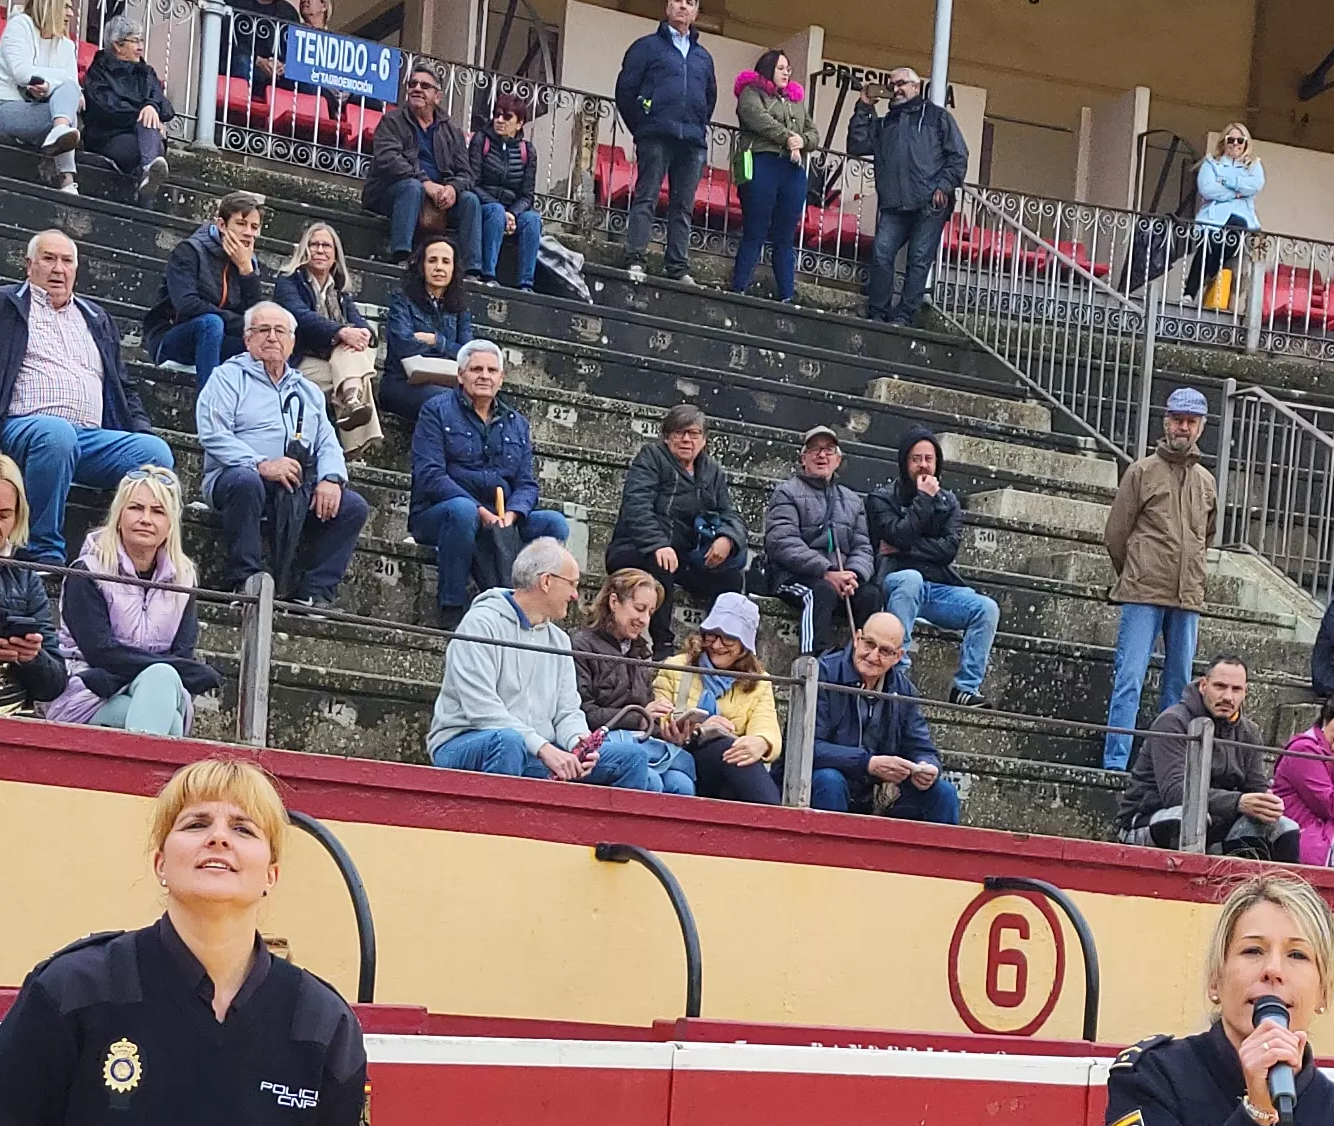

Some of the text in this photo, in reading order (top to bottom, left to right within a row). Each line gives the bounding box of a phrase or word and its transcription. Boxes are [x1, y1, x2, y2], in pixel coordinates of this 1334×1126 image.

[295, 29, 367, 77] TENDIDO
[553, 408, 572, 421] 27
[374, 559, 394, 577] 20
[985, 912, 1031, 1008] 6
[260, 1080, 320, 1102] POLICI
[277, 1094, 317, 1109] CNP
